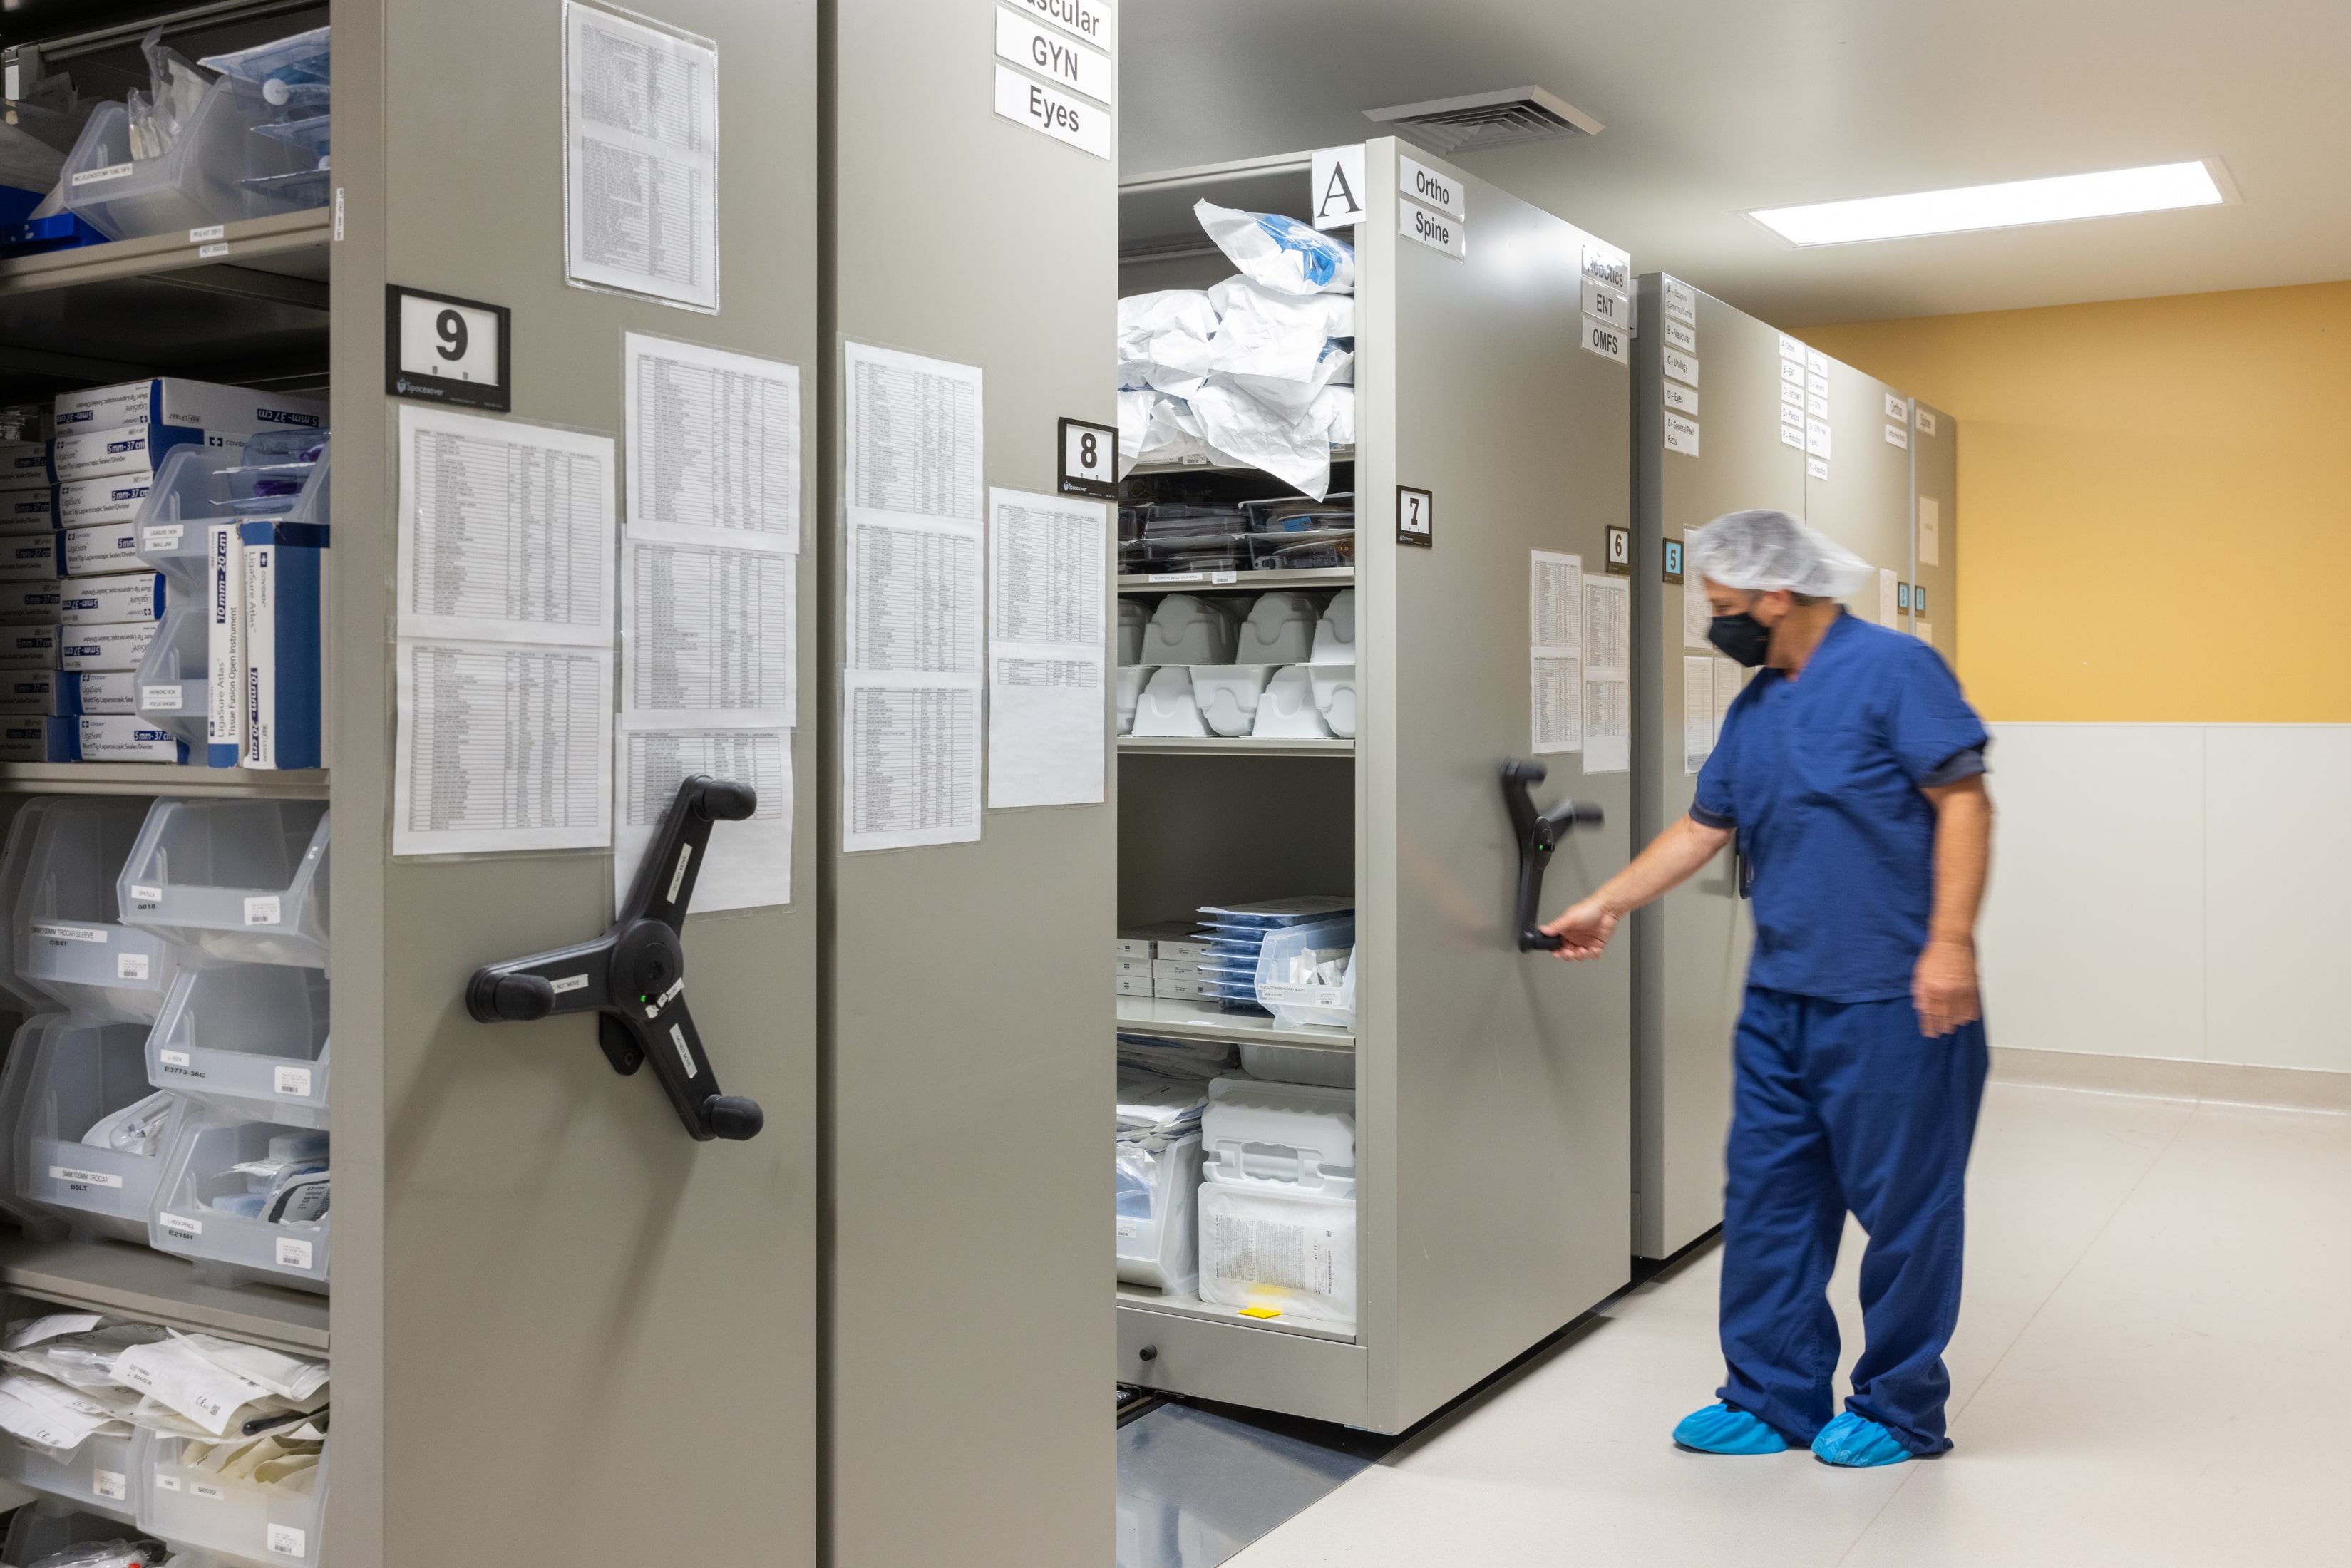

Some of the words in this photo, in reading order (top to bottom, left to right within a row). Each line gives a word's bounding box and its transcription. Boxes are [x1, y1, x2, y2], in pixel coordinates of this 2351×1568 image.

[1027, 0, 1099, 36] scular
[1032, 36, 1078, 81] GYN
[1030, 84, 1079, 132] Eyes
[1316, 161, 1363, 218] A
[1416, 170, 1449, 205] Ortho
[1416, 211, 1449, 244] Spine
[1667, 285, 1670, 294] A
[1597, 293, 1613, 317] ENT
[436, 309, 468, 361] 9
[1593, 328, 1618, 355] OMFS
[1667, 325, 1670, 334] B
[1674, 328, 1690, 344] Vascular
[1667, 356, 1670, 364] C
[1674, 358, 1687, 373] Urology
[406, 381, 445, 396] Spacesaver
[1667, 390, 1670, 399] D
[1674, 392, 1683, 404] Eyes
[258, 409, 272, 419] cm
[274, 411, 287, 422] 37
[1891, 401, 1902, 417] Ortho
[66, 414, 73, 423] 37
[1674, 421, 1686, 433] General
[127, 441, 135, 450] 37
[1667, 434, 1677, 445] Packs
[57, 452, 76, 462] LigaSure
[1081, 433, 1098, 469] 8
[131, 489, 139, 498] 37
[140, 488, 149, 497] cm
[61, 497, 81, 507] LigaSure
[1410, 497, 1419, 526] 7
[68, 544, 87, 554] LigaSure
[219, 532, 227, 554] cm
[1615, 534, 1622, 557] 6
[218, 555, 226, 572] 20
[1670, 549, 1676, 570] 5
[1901, 588, 1905, 605] 2
[71, 600, 79, 609] 37
[229, 656, 237, 679] Open
[83, 686, 102, 694] LigaSure
[252, 719, 259, 734] 20
[82, 732, 102, 741] LigaSure
[155, 731, 163, 740] 37
[253, 740, 259, 759] cm
[164, 1066, 205, 1078] E3773-36C
[89, 1174, 108, 1182] TROCAR
[168, 1229, 192, 1240] E215H
[197, 1486, 217, 1495] BABCOCK
